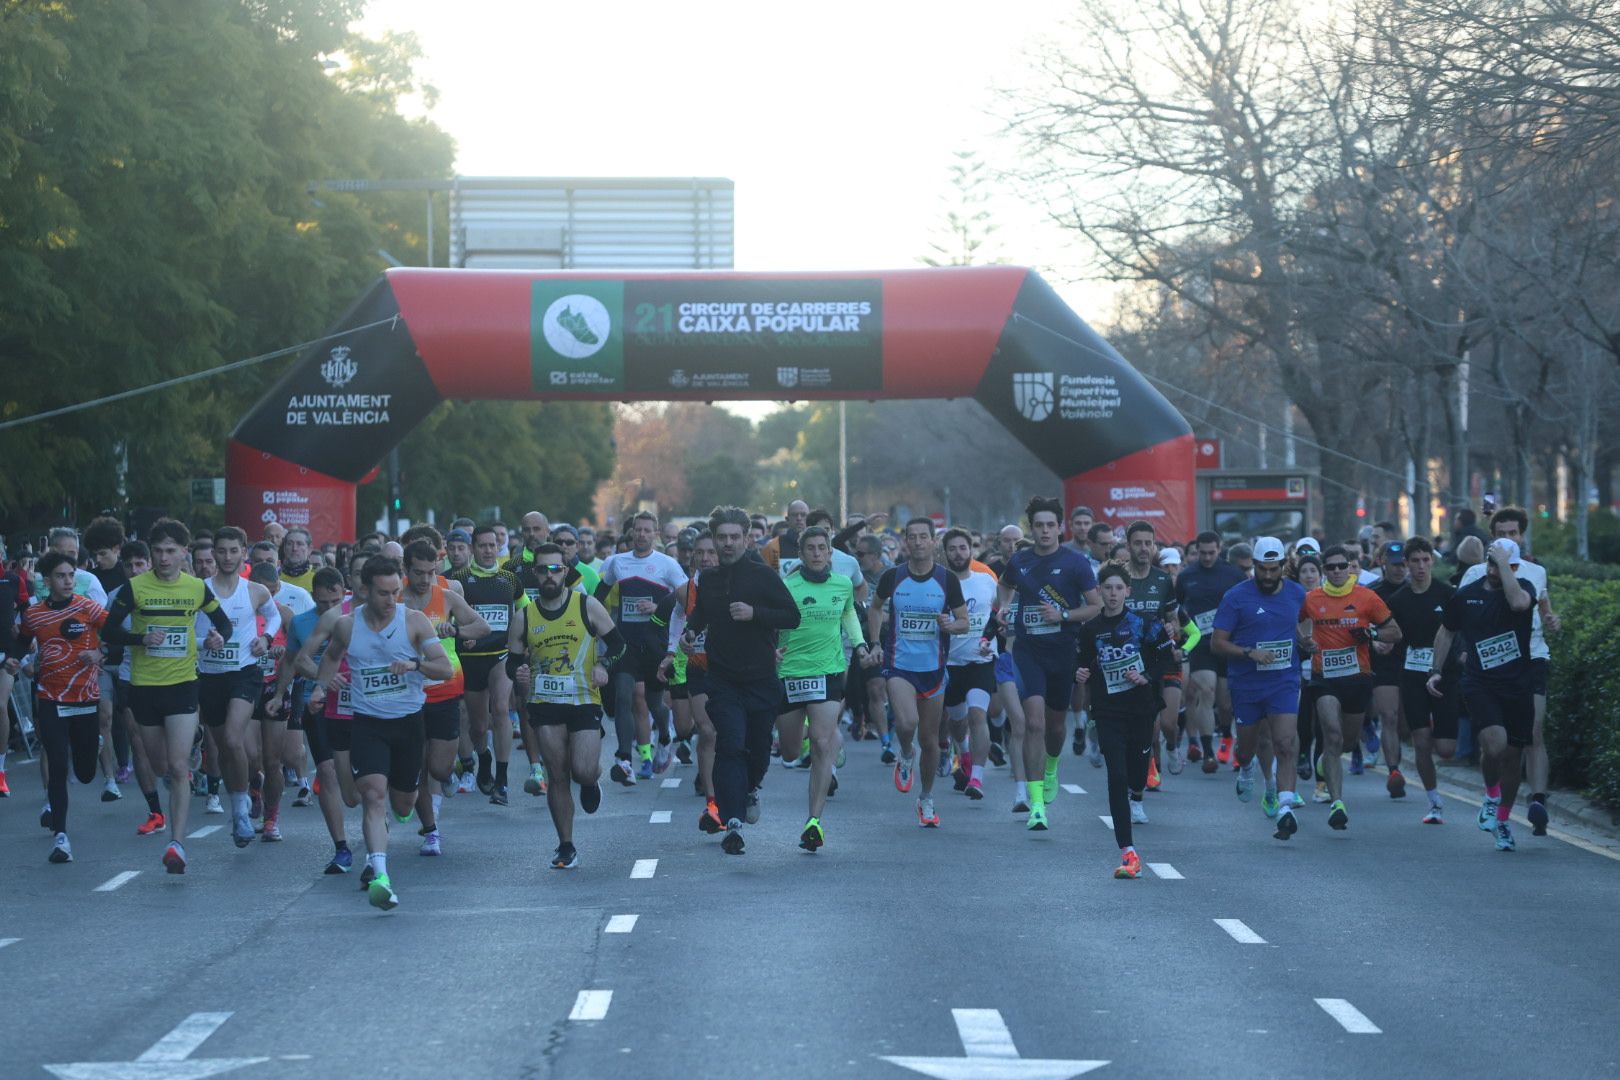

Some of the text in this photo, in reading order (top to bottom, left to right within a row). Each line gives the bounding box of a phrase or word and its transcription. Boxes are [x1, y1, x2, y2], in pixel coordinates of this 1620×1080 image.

[678, 302, 871, 315] CIRCUIT DE CARRERES
[635, 303, 673, 333] 21
[678, 315, 860, 333] CAIXA POPULAR
[288, 394, 392, 409] AJUNTAMENT
[286, 411, 307, 425] DE
[144, 598, 195, 606] CORRECAMINOS
[902, 619, 931, 630] 8677
[970, 617, 982, 626] 34
[1340, 617, 1359, 625] STOP
[166, 634, 181, 645] 12
[1271, 648, 1289, 659] 39
[1480, 641, 1513, 658] 5242
[1324, 654, 1353, 667] 8959
[363, 674, 400, 689] 7548
[543, 680, 565, 691] 601
[788, 680, 819, 692] 8160
[340, 691, 352, 703] 8
